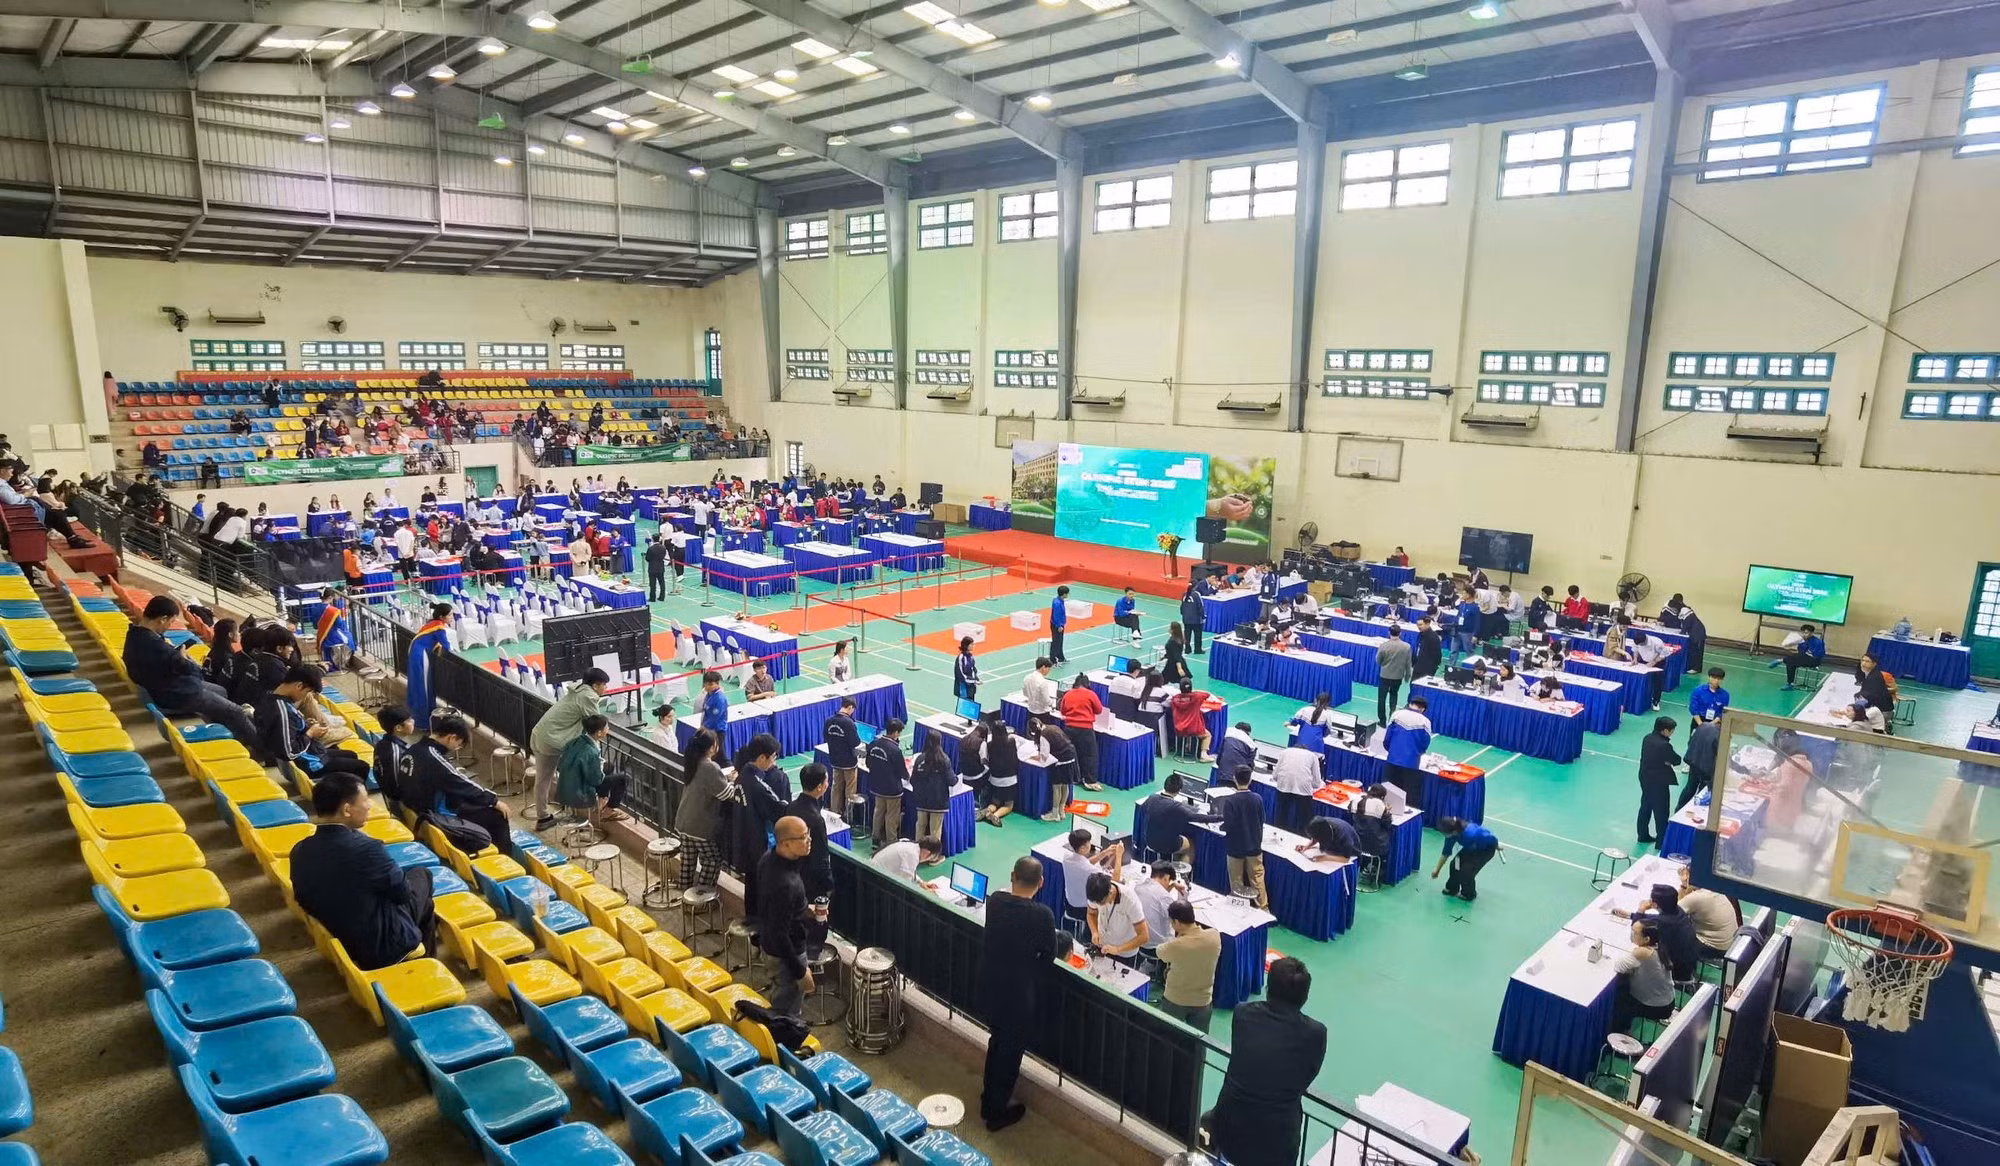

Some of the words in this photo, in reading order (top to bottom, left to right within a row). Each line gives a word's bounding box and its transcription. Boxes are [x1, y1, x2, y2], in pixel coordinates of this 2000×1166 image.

[1767, 583, 1795, 592] OLYMPIC
[1795, 586, 1812, 594] STEM
[1231, 898, 1245, 906] P23
